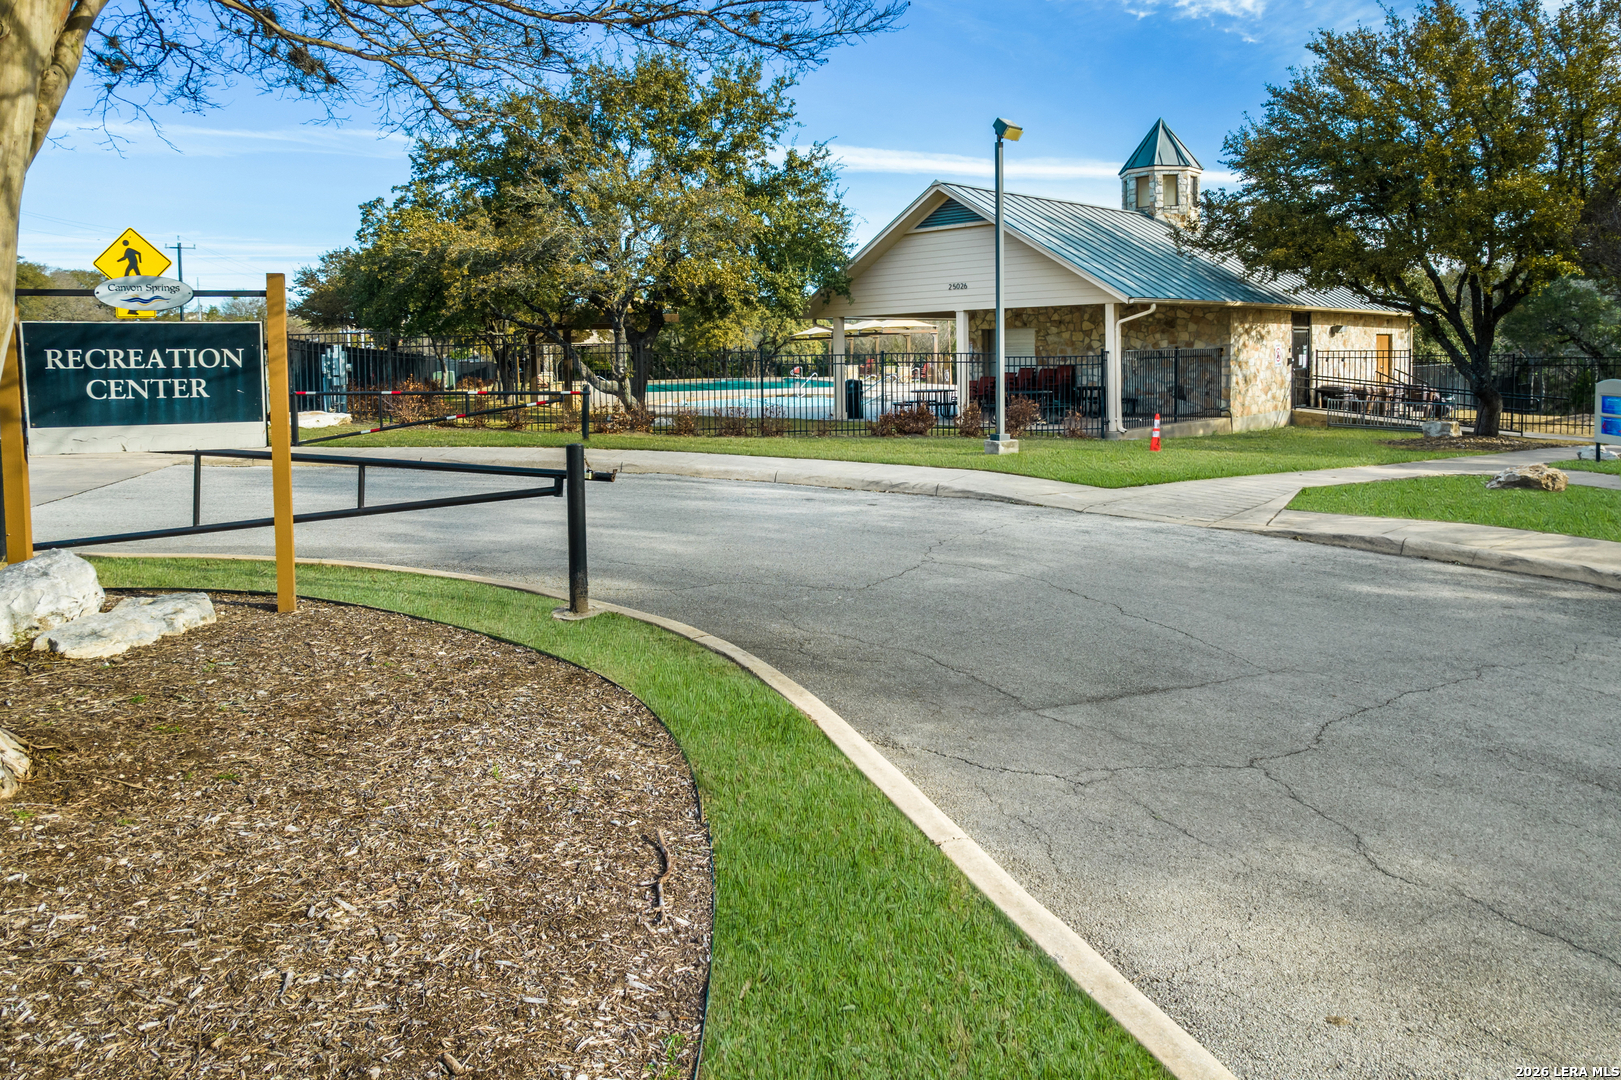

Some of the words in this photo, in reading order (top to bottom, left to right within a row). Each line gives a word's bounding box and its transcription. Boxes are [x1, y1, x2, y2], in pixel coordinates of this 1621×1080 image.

[107, 283, 143, 294] Canyon
[145, 283, 181, 294] Springs
[948, 282, 968, 291] 25026
[44, 348, 244, 370] RECREATION
[86, 378, 210, 400] CENTER
